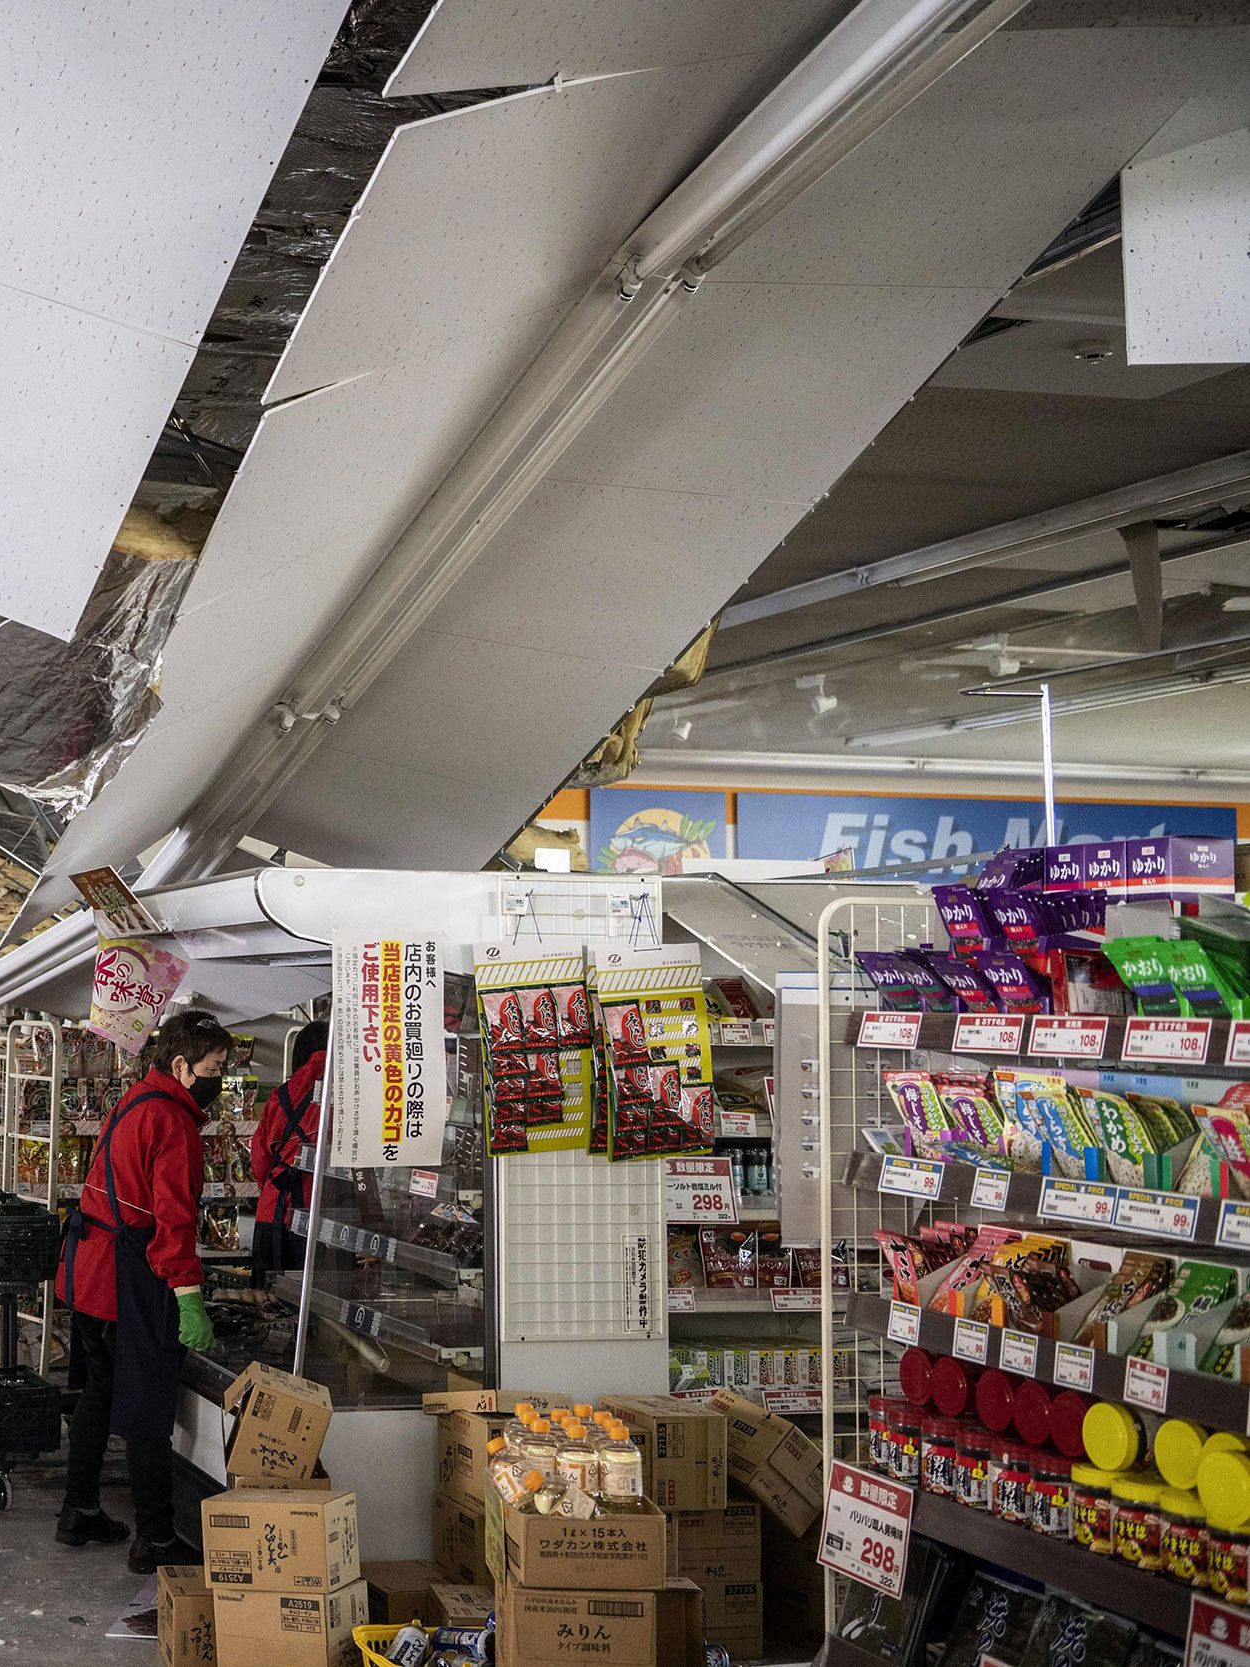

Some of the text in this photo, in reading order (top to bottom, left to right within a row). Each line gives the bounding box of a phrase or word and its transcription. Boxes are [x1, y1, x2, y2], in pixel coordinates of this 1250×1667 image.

[819, 813, 973, 874] Fish
[1132, 856, 1165, 875] ゆかり
[1189, 851, 1217, 864] ゆかり
[1050, 862, 1080, 880] ゆかり
[1088, 859, 1120, 878] ゆかり
[941, 904, 974, 922] ゆかり
[994, 906, 1027, 925] ゆかり
[425, 941, 437, 988] お客様へ
[1123, 959, 1163, 977] かおり
[1168, 963, 1208, 982] かおり
[94, 949, 166, 1016] 春の味覚
[871, 969, 907, 985] ゆかり
[942, 974, 977, 989] ゆかり
[985, 967, 1023, 985] ゆかり
[361, 942, 382, 1073] ご使用下さい。
[899, 1028, 912, 1039] 108
[1158, 1022, 1188, 1032] おすすめ品
[404, 943, 425, 1138] 店内のお買廻りの際は
[999, 1031, 1013, 1043] 108
[1080, 1034, 1096, 1047] 108
[1180, 1037, 1198, 1050] 108
[382, 942, 403, 1161] 当店指定の黄色のカゴを
[1102, 1101, 1126, 1153] わかめ
[676, 1161, 715, 1174] 数量限定
[892, 1159, 934, 1172] SPECIAL PRICE
[924, 1177, 935, 1188] 99
[1054, 1182, 1105, 1196] SPECIAL PRICE
[1094, 1201, 1108, 1214] 99
[1129, 1192, 1184, 1207] SPECIAL PRICE
[1173, 1213, 1188, 1227] 99
[811, 1297, 822, 1305] 29
[658, 1426, 666, 1456] 27135
[931, 1456, 947, 1486] 男梅
[860, 1480, 898, 1511] 数量限定
[1004, 1481, 1018, 1513] 男梅
[726, 1507, 753, 1515] 27135
[264, 1522, 278, 1565] そうめん
[277, 1543, 289, 1560] つゆ
[539, 1540, 647, 1551] ワダカン株式会社
[218, 1573, 245, 1582] A2519
[288, 1601, 312, 1609] A2519
[557, 1623, 611, 1640] みりん
[202, 1621, 214, 1661] そうめん
[557, 1642, 611, 1654] タイプ調味料
